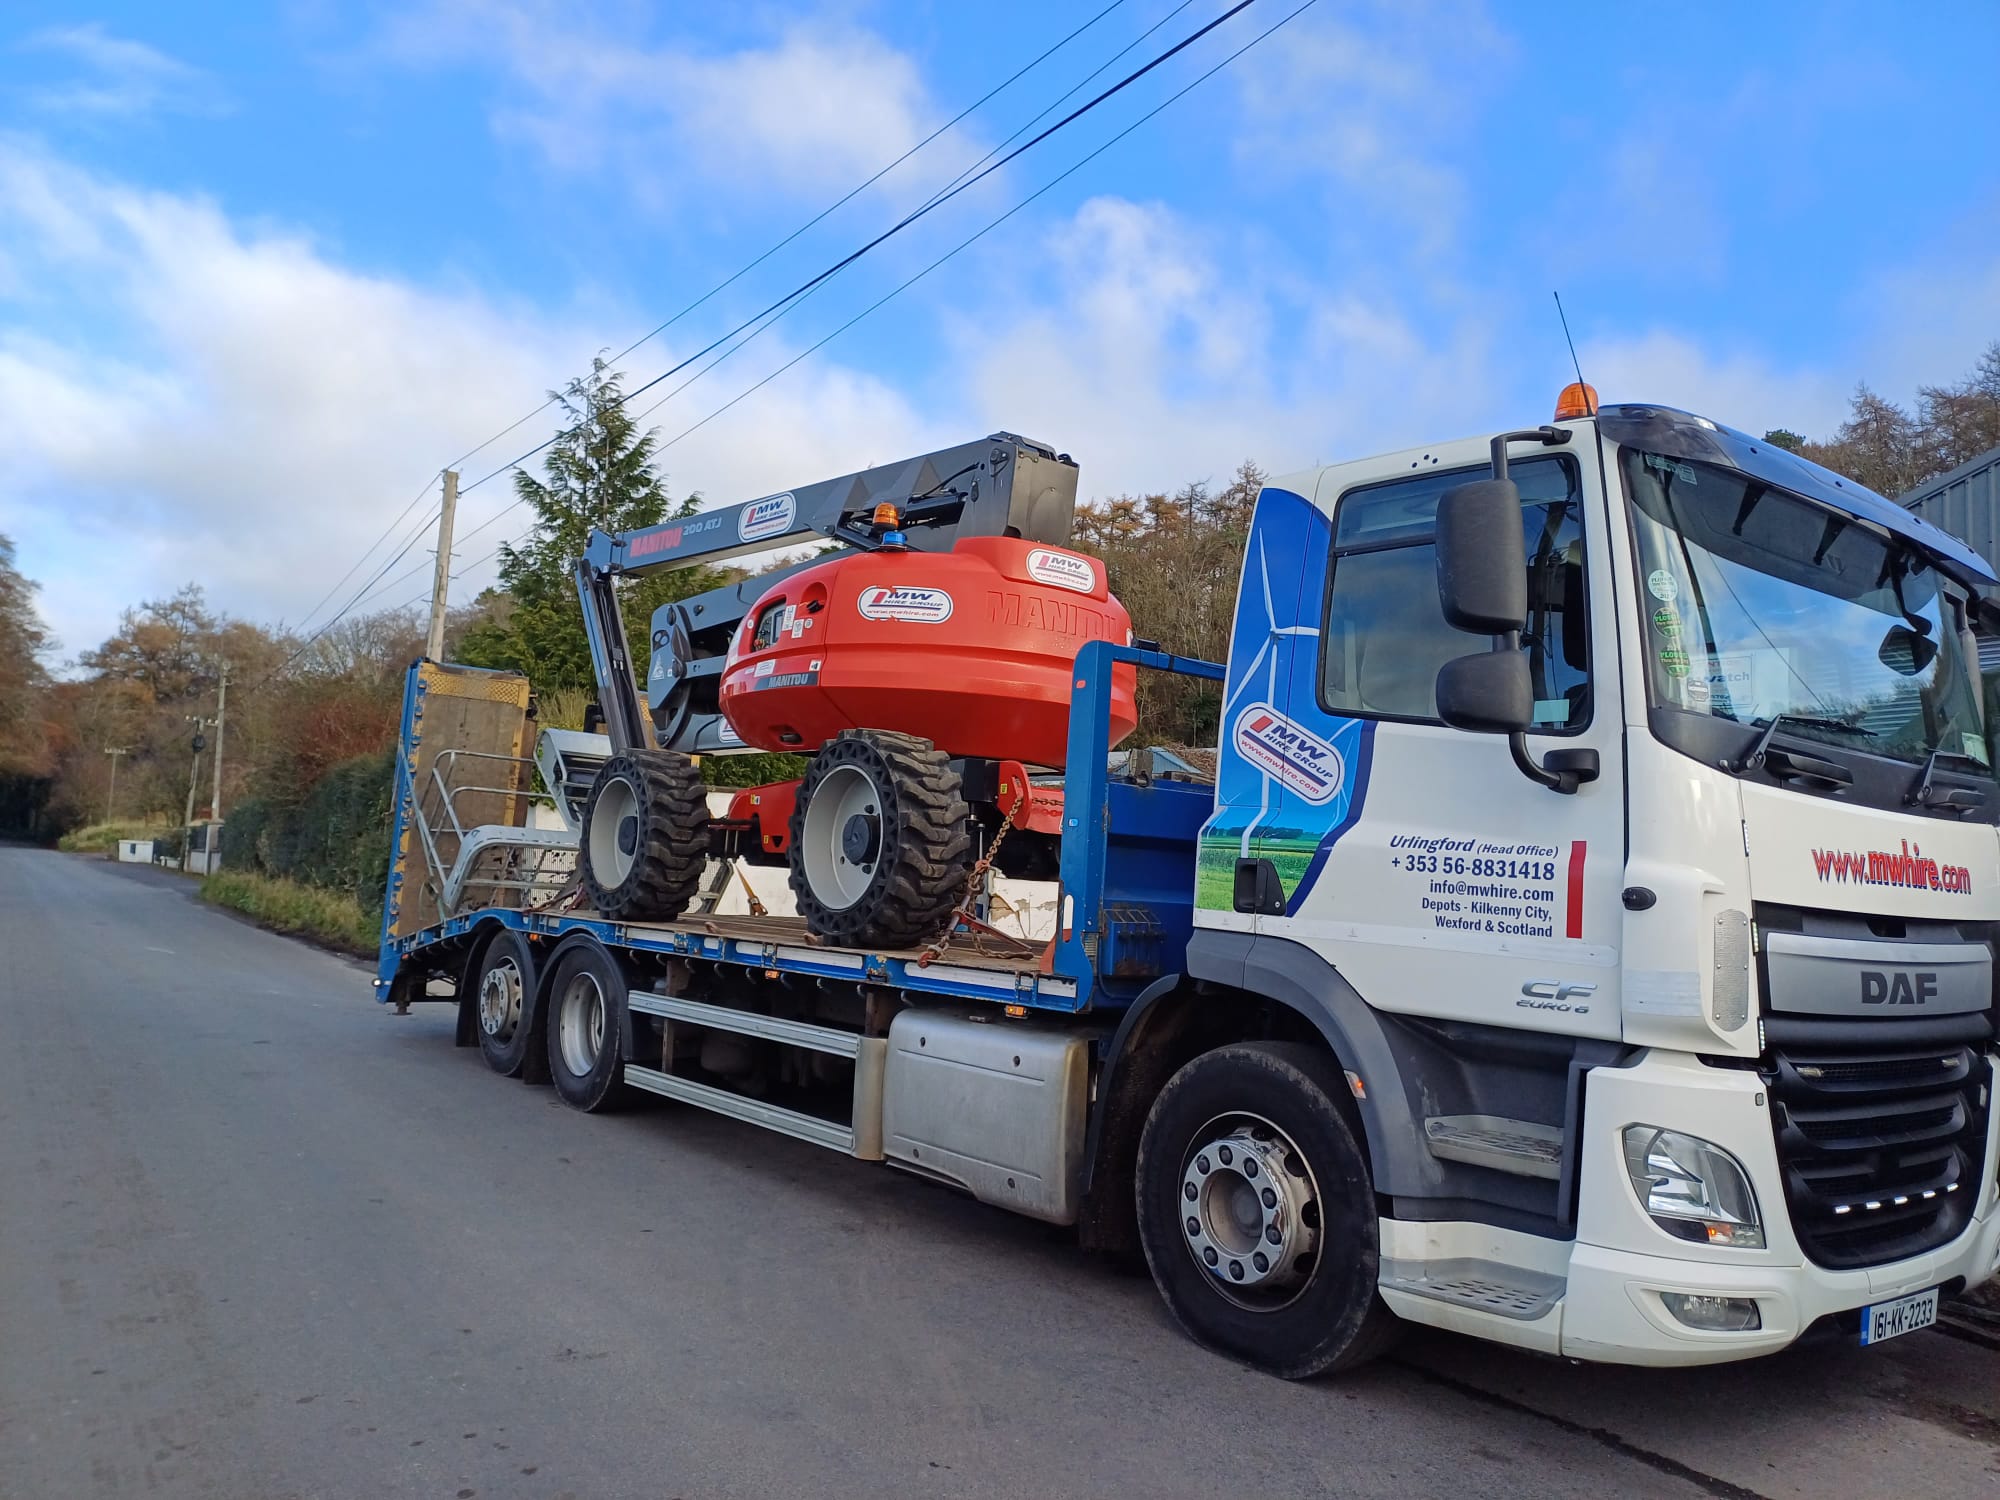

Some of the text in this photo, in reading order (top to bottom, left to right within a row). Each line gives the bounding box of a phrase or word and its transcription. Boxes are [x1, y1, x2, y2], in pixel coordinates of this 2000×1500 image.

[756, 500, 784, 515] MW
[683, 522, 701, 536] 200
[703, 517, 722, 531] ATJ
[1051, 557, 1083, 570] MW
[888, 592, 934, 601] MW
[768, 673, 809, 688] MANITOU
[1270, 724, 1328, 760] MW
[1241, 740, 1320, 795] www.mwhire.com
[1263, 733, 1334, 779] HIRE GROUP
[1389, 835, 1560, 859] Urlingford (Head Office)
[1442, 857, 1555, 881] 56-8831418
[1811, 838, 1972, 895] www.mwhire.com
[1429, 879, 1555, 902] info@mwhire.com
[1422, 897, 1461, 913] Depots
[1471, 901, 1522, 920] Kilkenny
[1525, 905, 1553, 922] City,
[1435, 915, 1553, 938] Wexford & Scotland
[1521, 979, 1598, 1000] CF
[1860, 971, 1938, 1005] DAF
[1516, 1000, 1590, 1014] EURO 6
[1873, 1298, 1933, 1341] 161-KK-2233
